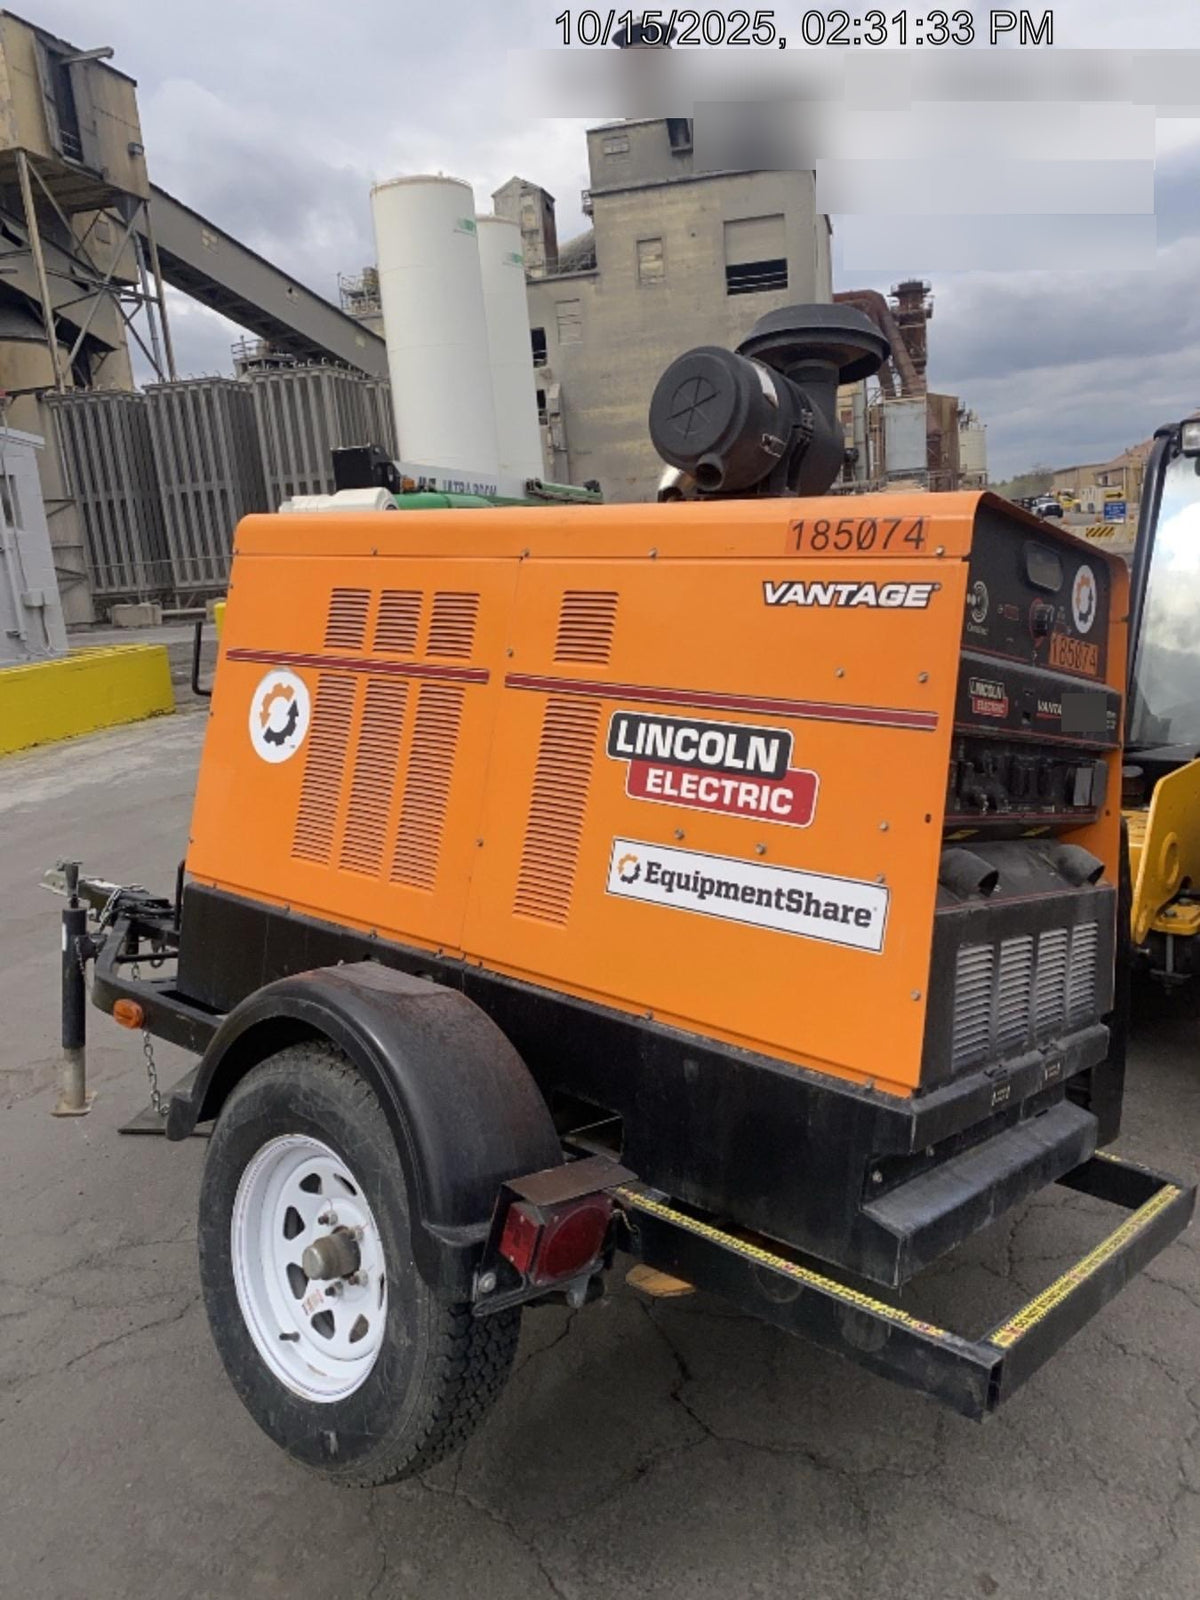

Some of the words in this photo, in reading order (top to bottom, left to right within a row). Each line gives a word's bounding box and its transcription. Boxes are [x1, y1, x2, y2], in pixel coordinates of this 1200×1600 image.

[791, 516, 926, 551] 185074
[763, 582, 936, 608] VANTAGE
[1052, 636, 1096, 671] 185074
[969, 680, 1005, 700] LINCOLN
[977, 699, 1005, 715] ELECTRIC
[1037, 699, 1062, 715] VANTA
[616, 719, 780, 773] LINCOLN
[645, 767, 794, 815] ELECTRIC
[644, 860, 873, 928] EquipmentShare
